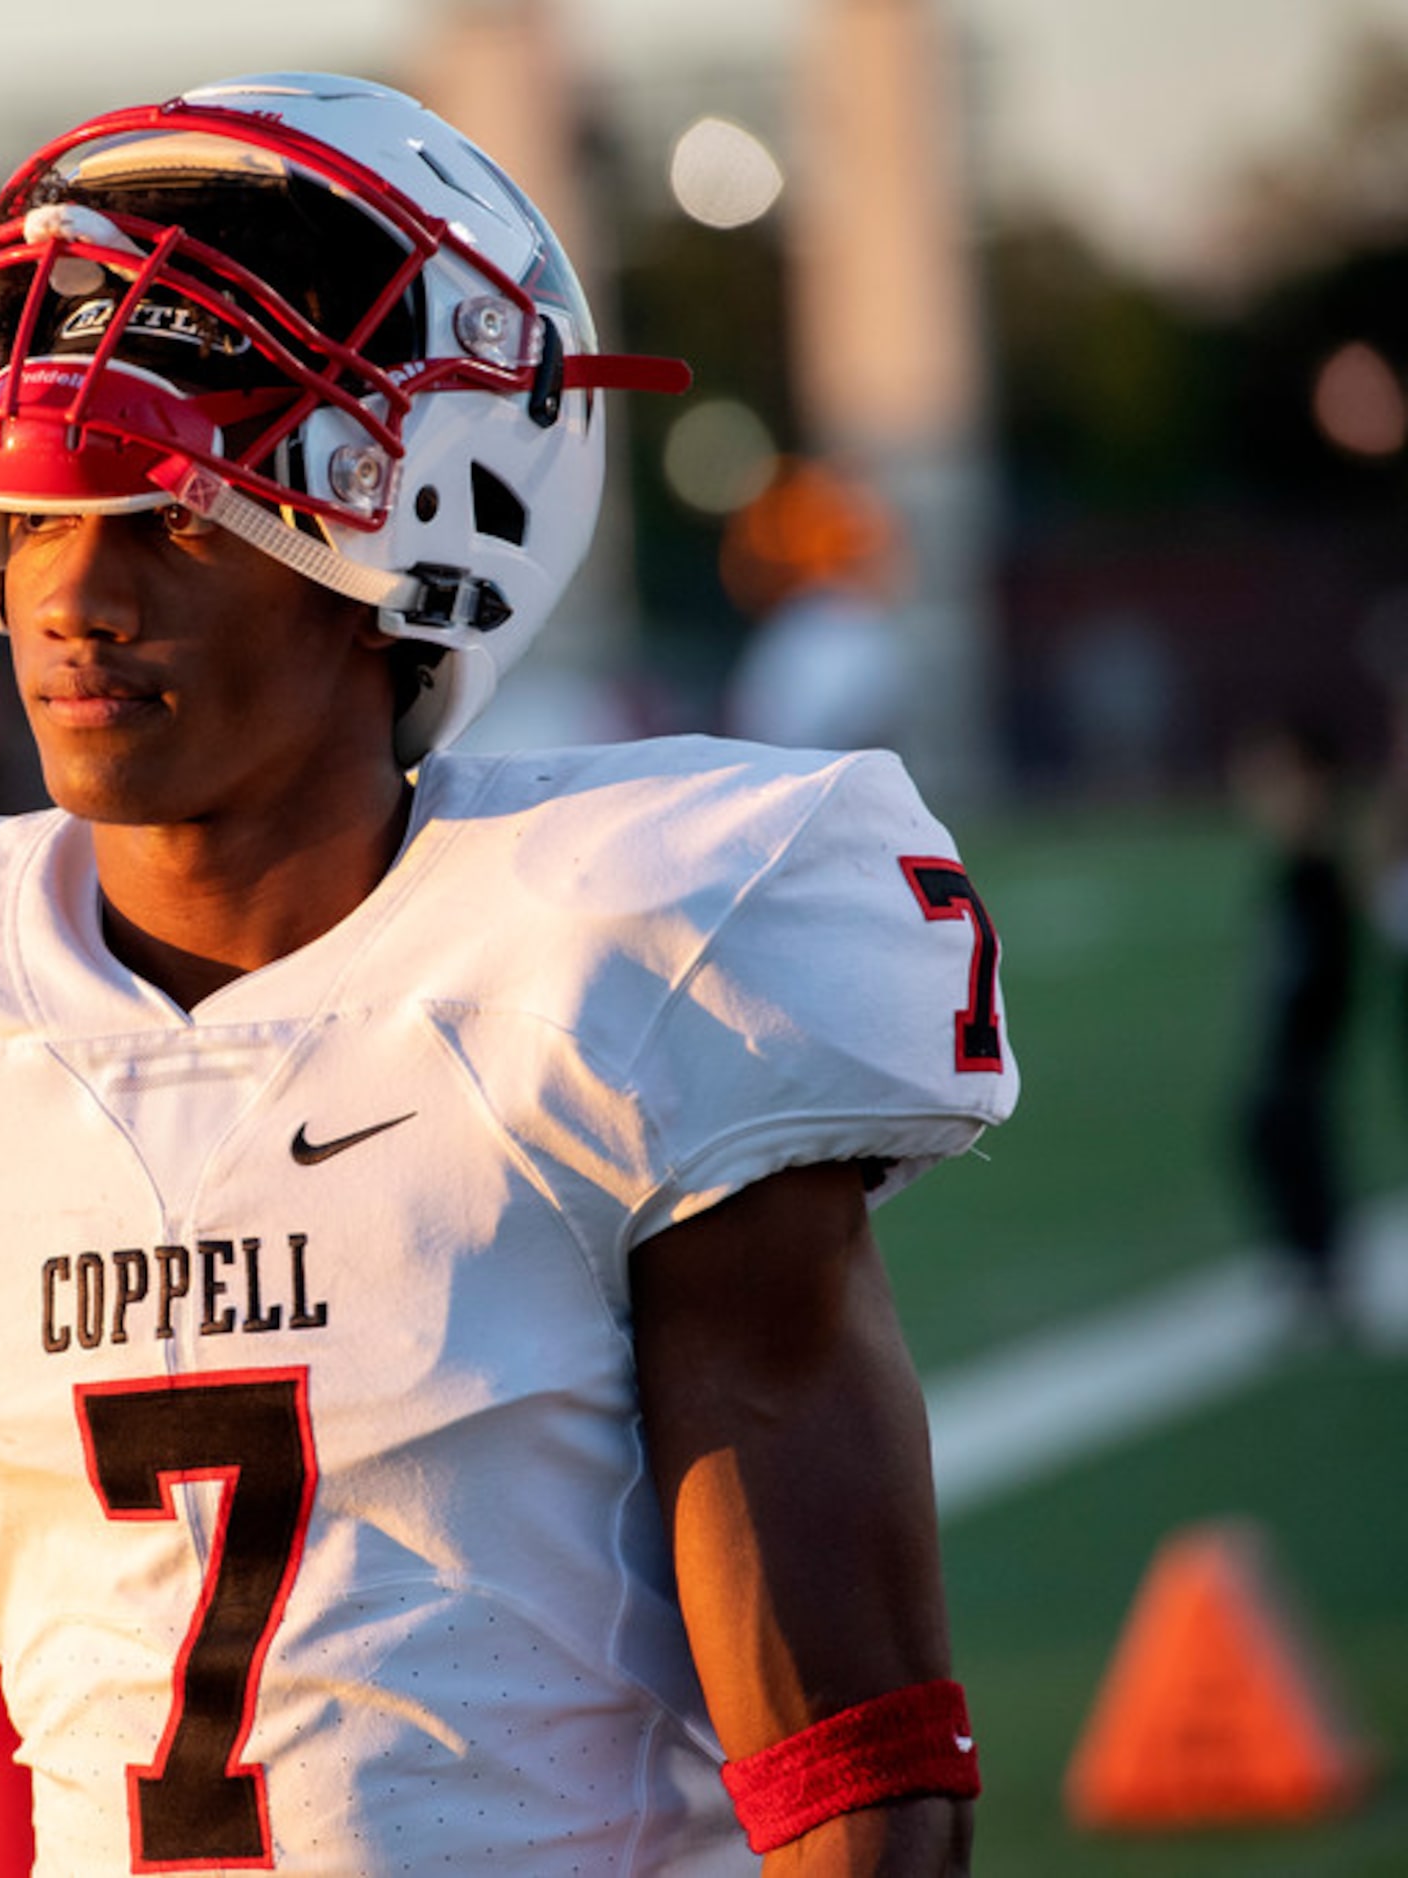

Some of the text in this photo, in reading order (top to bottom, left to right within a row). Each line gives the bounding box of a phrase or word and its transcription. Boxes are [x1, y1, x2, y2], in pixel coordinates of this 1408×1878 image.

[75, 300, 214, 340] BATTL
[898, 855, 1004, 1075] 7
[42, 1233, 328, 1353] COPPELL
[73, 1365, 319, 1875] 7
